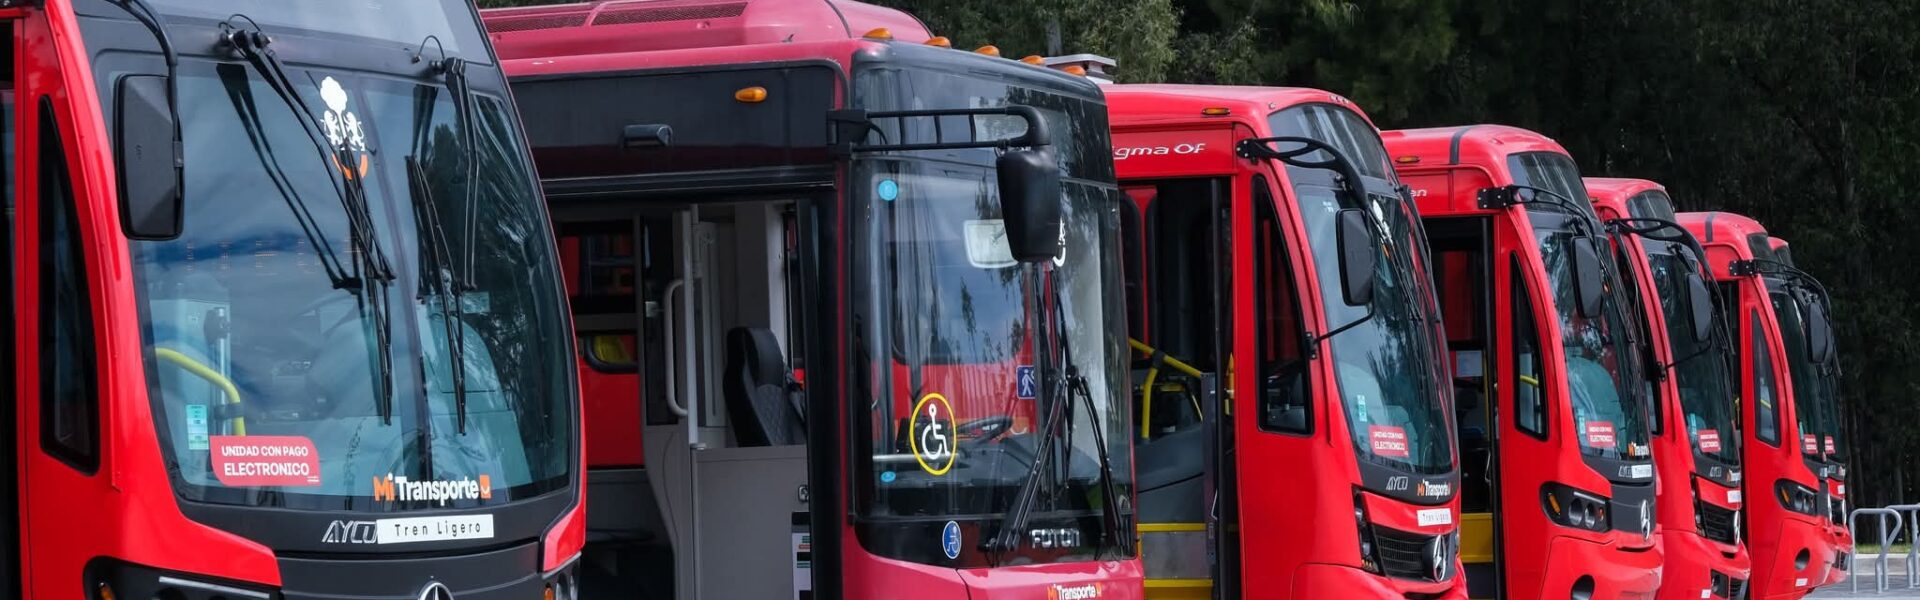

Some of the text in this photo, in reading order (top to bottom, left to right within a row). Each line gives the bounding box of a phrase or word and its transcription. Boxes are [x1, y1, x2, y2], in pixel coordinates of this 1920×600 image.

[221, 445, 308, 457] UNIDAD CON PAGO
[224, 462, 310, 476] ELECTRONICO
[373, 472, 479, 506] Mi Transporte
[394, 519, 481, 537] Tren Ligero
[1056, 584, 1096, 600] Transporte
